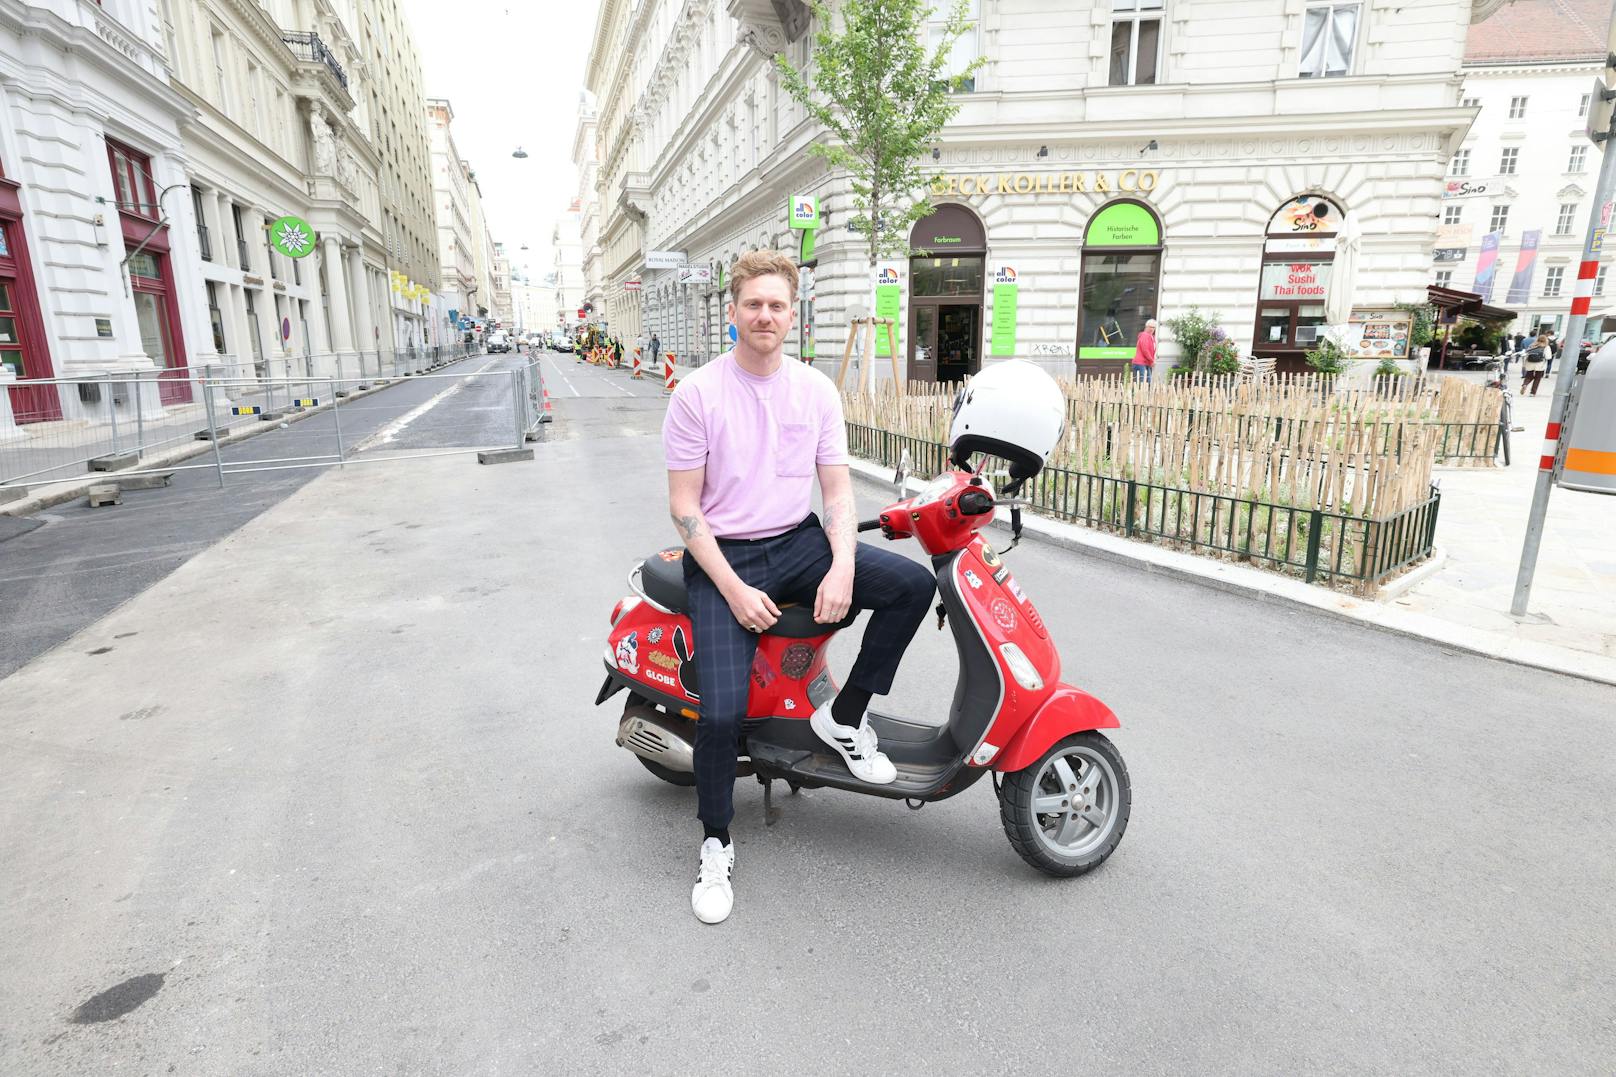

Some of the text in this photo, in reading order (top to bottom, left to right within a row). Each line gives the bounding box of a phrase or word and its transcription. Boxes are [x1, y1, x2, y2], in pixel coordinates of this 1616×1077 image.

[997, 173, 1086, 194] KOLLER
[1094, 171, 1109, 193] &
[1118, 168, 1159, 192] CO
[879, 268, 888, 278] all
[996, 266, 1006, 276] all
[1288, 274, 1316, 284] Sushi
[1273, 285, 1326, 295] Thai foods
[645, 669, 676, 687] GLOBE
